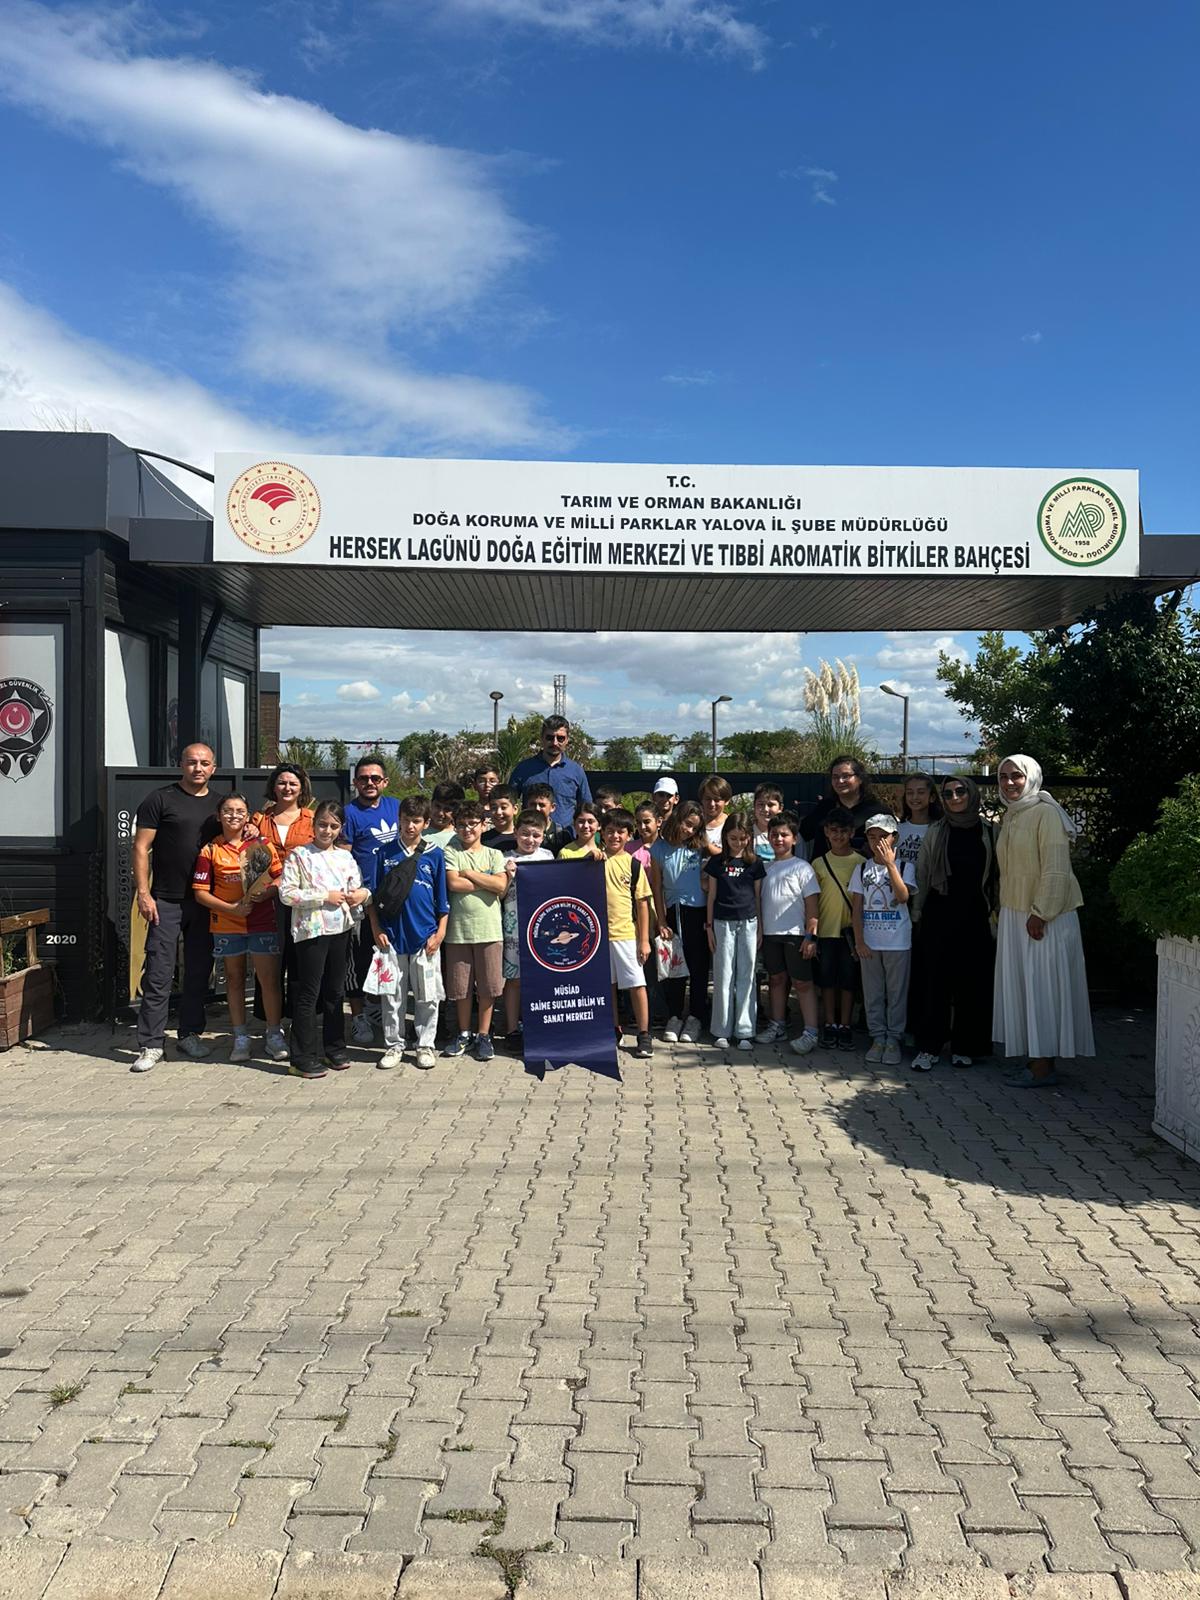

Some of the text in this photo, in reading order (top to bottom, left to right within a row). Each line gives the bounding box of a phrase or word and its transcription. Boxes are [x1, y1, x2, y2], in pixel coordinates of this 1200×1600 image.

[666, 475, 696, 488] T.C.
[1052, 487, 1071, 503] MİLLİ
[1071, 485, 1106, 498] PARKLAR
[561, 495, 801, 510] TARIM VE ORMAN BAKANLIĞI
[1046, 502, 1055, 512] VE
[1104, 497, 1119, 521] GENEL
[413, 510, 948, 535] DOĞA KORUMA VE MİLLİ PARKLAR YALOVA İL ŞUBE MÜDÜRLÜĞÜ
[1045, 514, 1059, 546] KORUMA
[330, 534, 1030, 575] HERSEK LAGÜNÜ DOĞA EĞİTİM MERKEZİ VE TIBBİ AROMATİK BİTKİLER BAHÇESİ
[8, 679, 39, 694] GÜVENLİK
[881, 911, 902, 921] RICA
[46, 935, 77, 945] 2020
[554, 984, 580, 996] MÜSİAD
[530, 995, 606, 1012] SAİME SULTAN BİLİM VE
[543, 1008, 594, 1024] SANAT MERKEZİ
